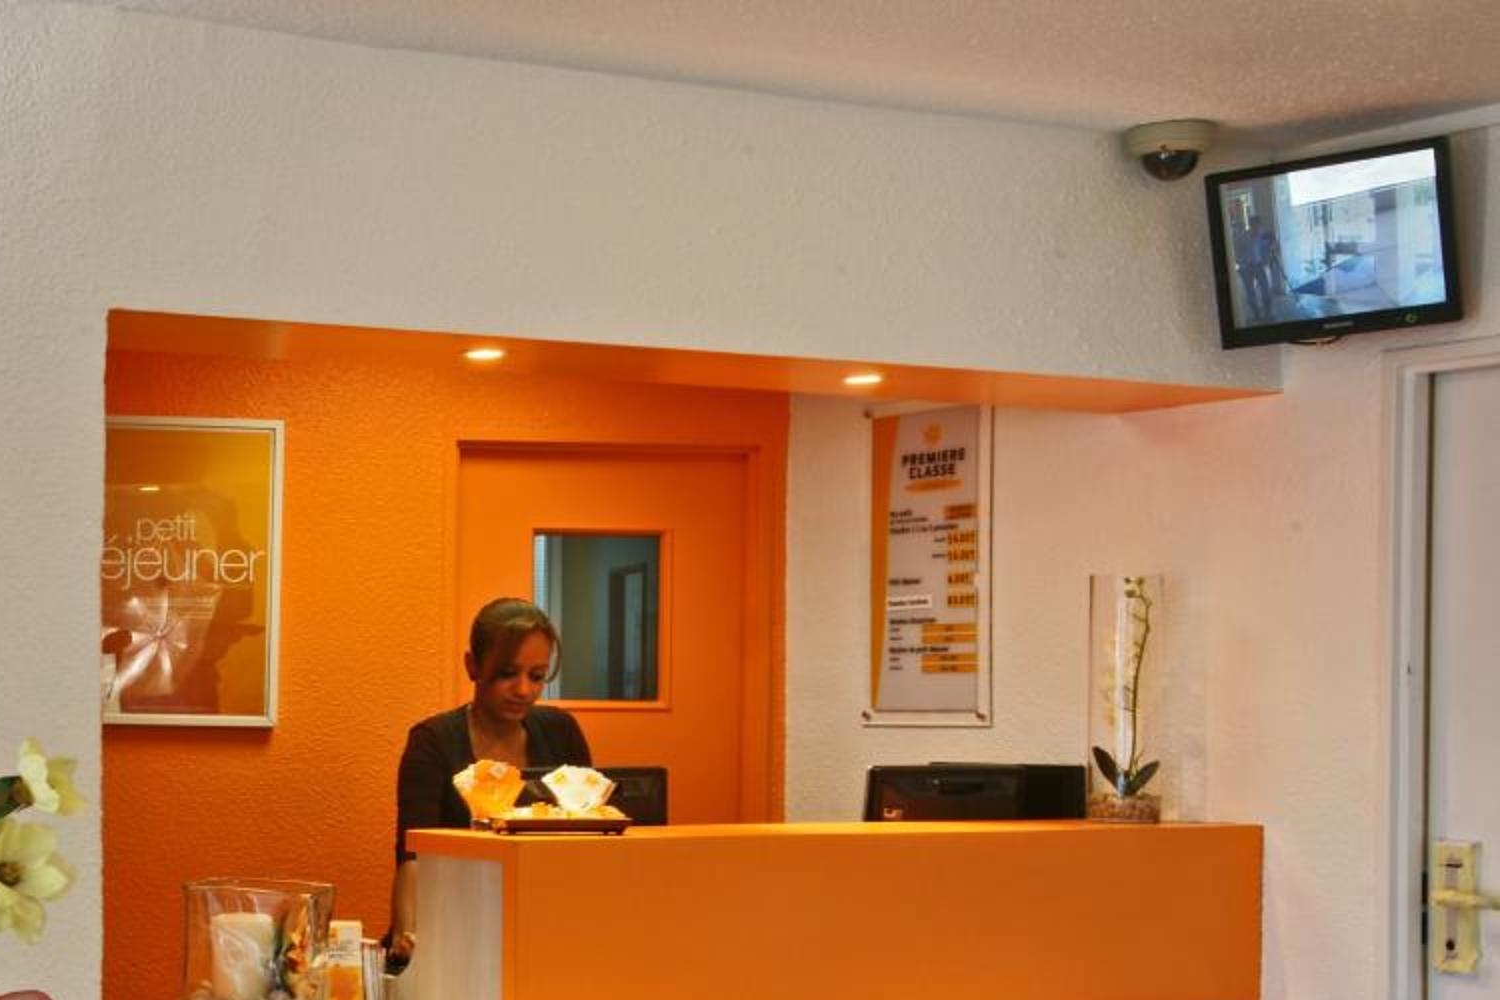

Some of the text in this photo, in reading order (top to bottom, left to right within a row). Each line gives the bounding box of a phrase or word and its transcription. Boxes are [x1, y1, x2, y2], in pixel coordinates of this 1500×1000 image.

[908, 463, 957, 480] CLASSE
[136, 512, 197, 545] petit
[100, 533, 266, 591] éjeuner
